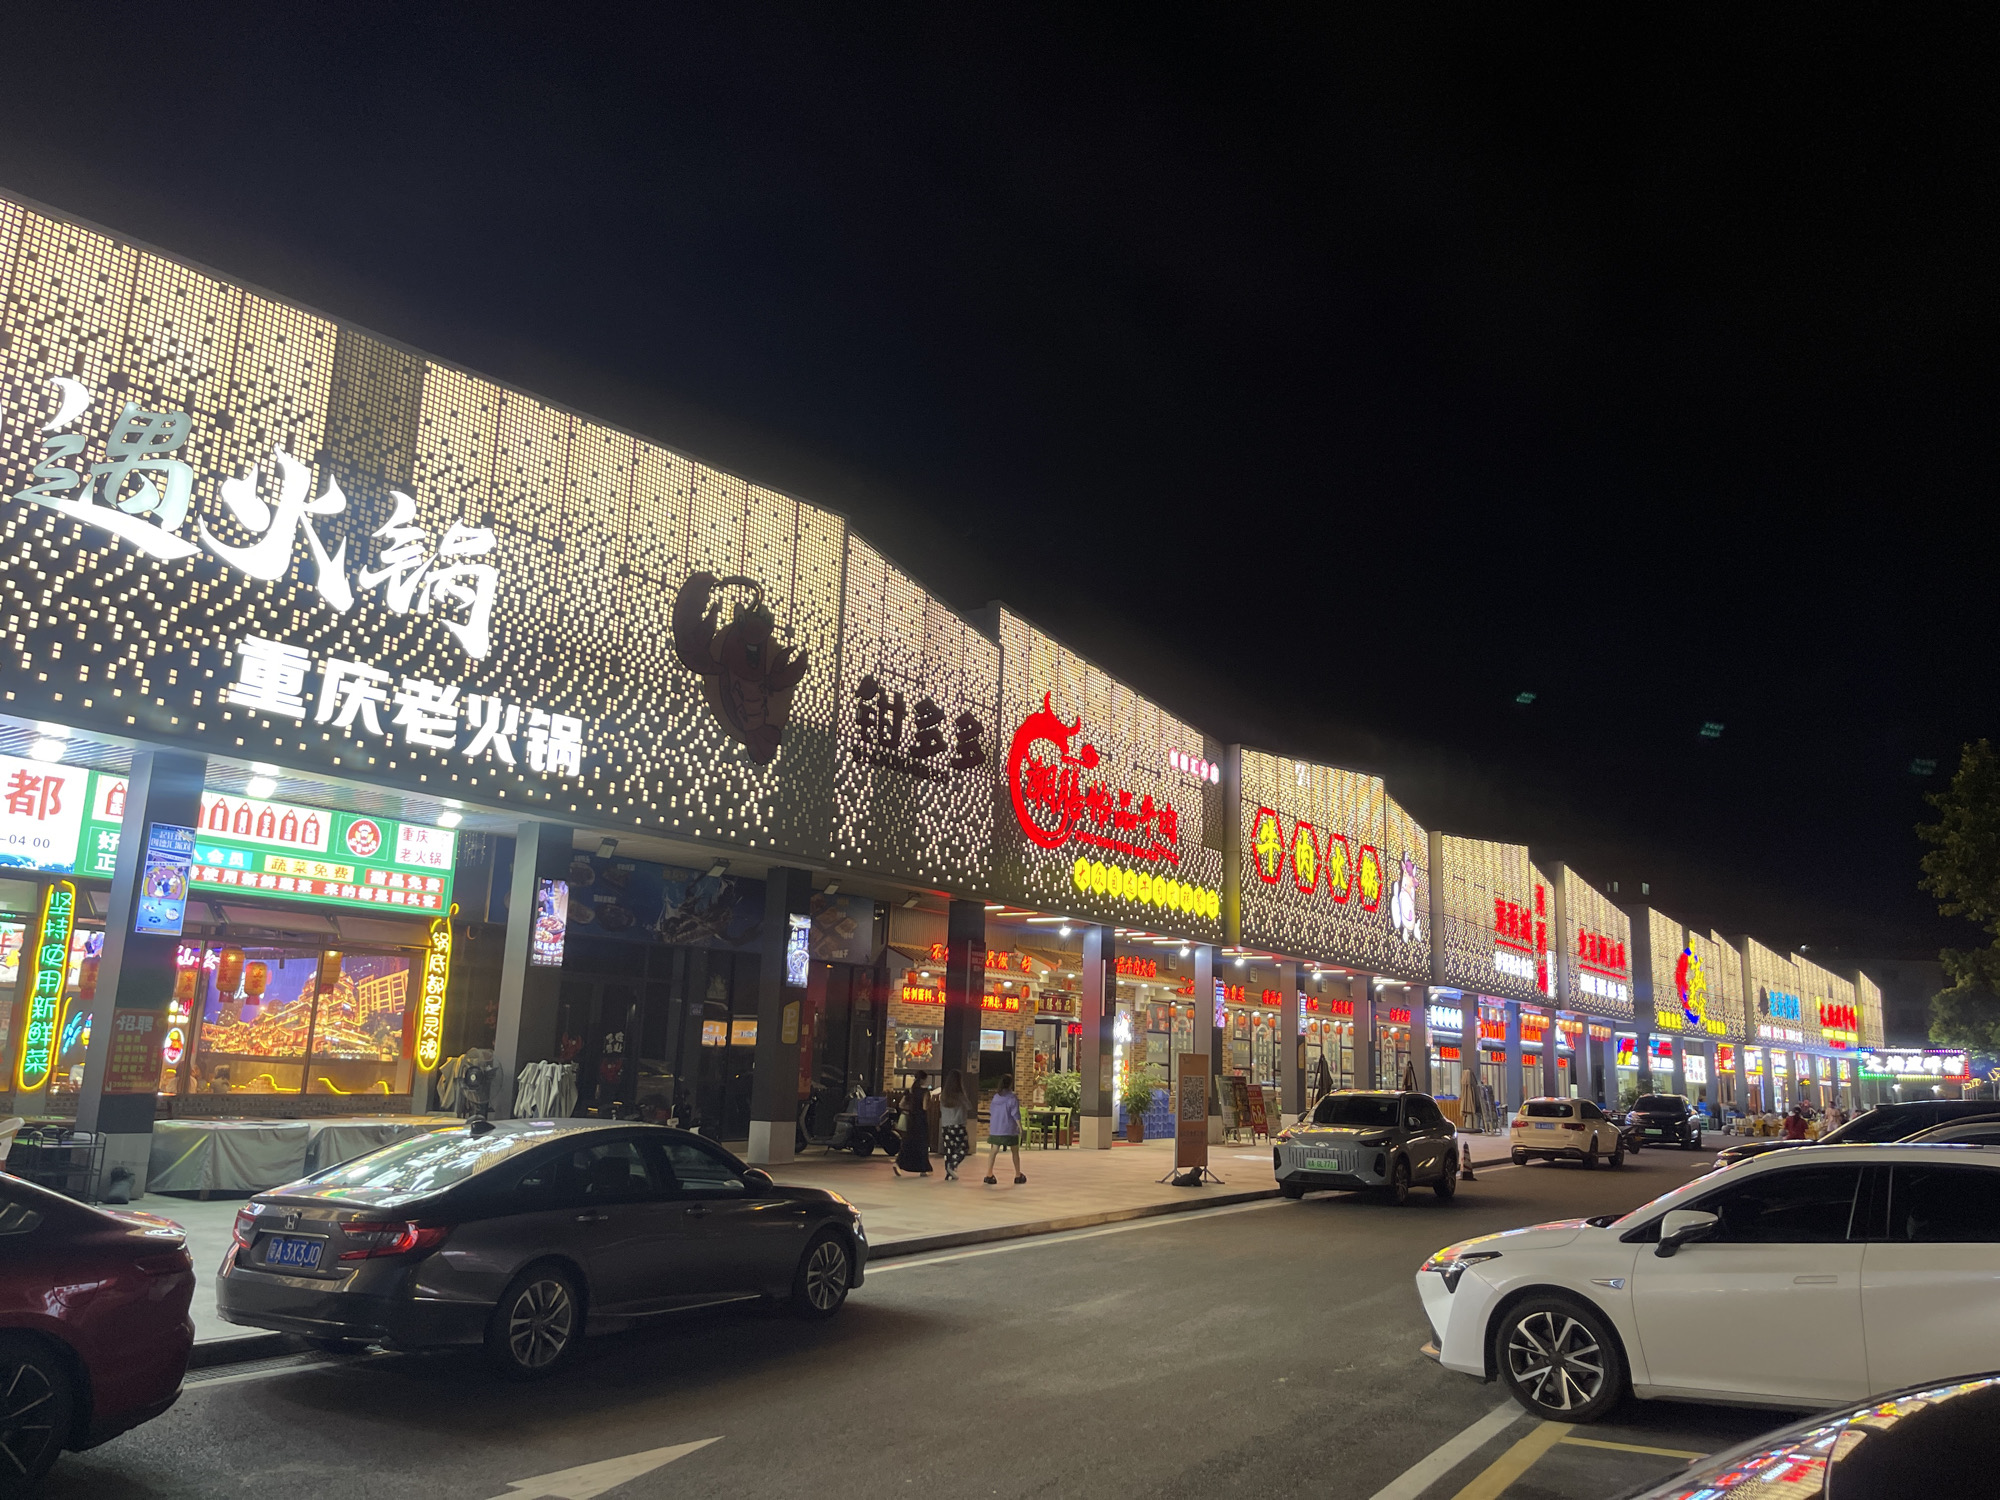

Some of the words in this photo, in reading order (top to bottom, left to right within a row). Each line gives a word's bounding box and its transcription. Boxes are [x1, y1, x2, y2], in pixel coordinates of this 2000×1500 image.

[228, 634, 583, 776] 重庆老火锅
[4, 769, 65, 821] 都
[272, 858, 349, 880] 蔬菜免费
[400, 848, 442, 865] 老火锅
[1257, 818, 1378, 900] 牛肉火锅
[25, 892, 73, 1073] 坚持使用新鲜菜
[1114, 955, 1157, 978] 品牛肉火锅
[420, 932, 449, 1060] 锅底都是灵魂
[116, 1015, 154, 1035] 招聘
